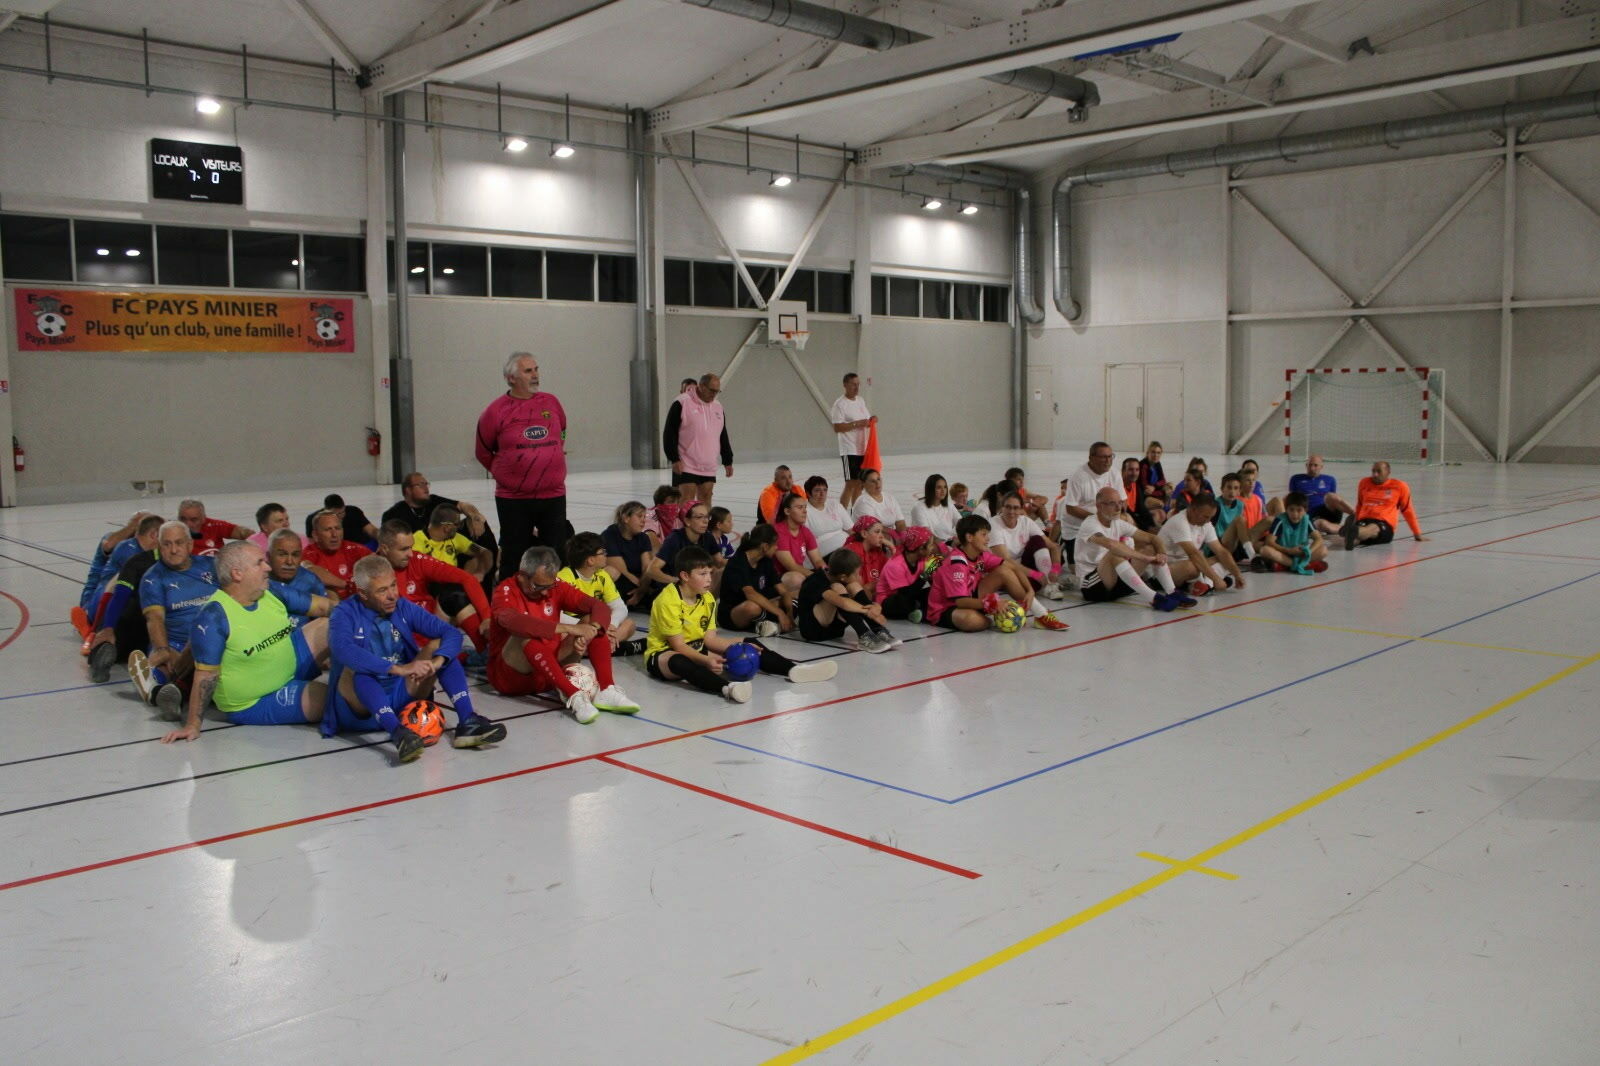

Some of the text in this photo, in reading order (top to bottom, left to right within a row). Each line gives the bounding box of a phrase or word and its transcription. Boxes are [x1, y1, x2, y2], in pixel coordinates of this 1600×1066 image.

[154, 154, 242, 172] LOCAUX VISITEURS
[211, 172, 220, 184] 0
[112, 298, 278, 317] FC PAYS MINIER
[25, 331, 76, 346] Pays Minier
[85, 320, 118, 336] Plus
[124, 320, 170, 340] qu'un
[174, 321, 210, 338] club,
[214, 325, 242, 337] une
